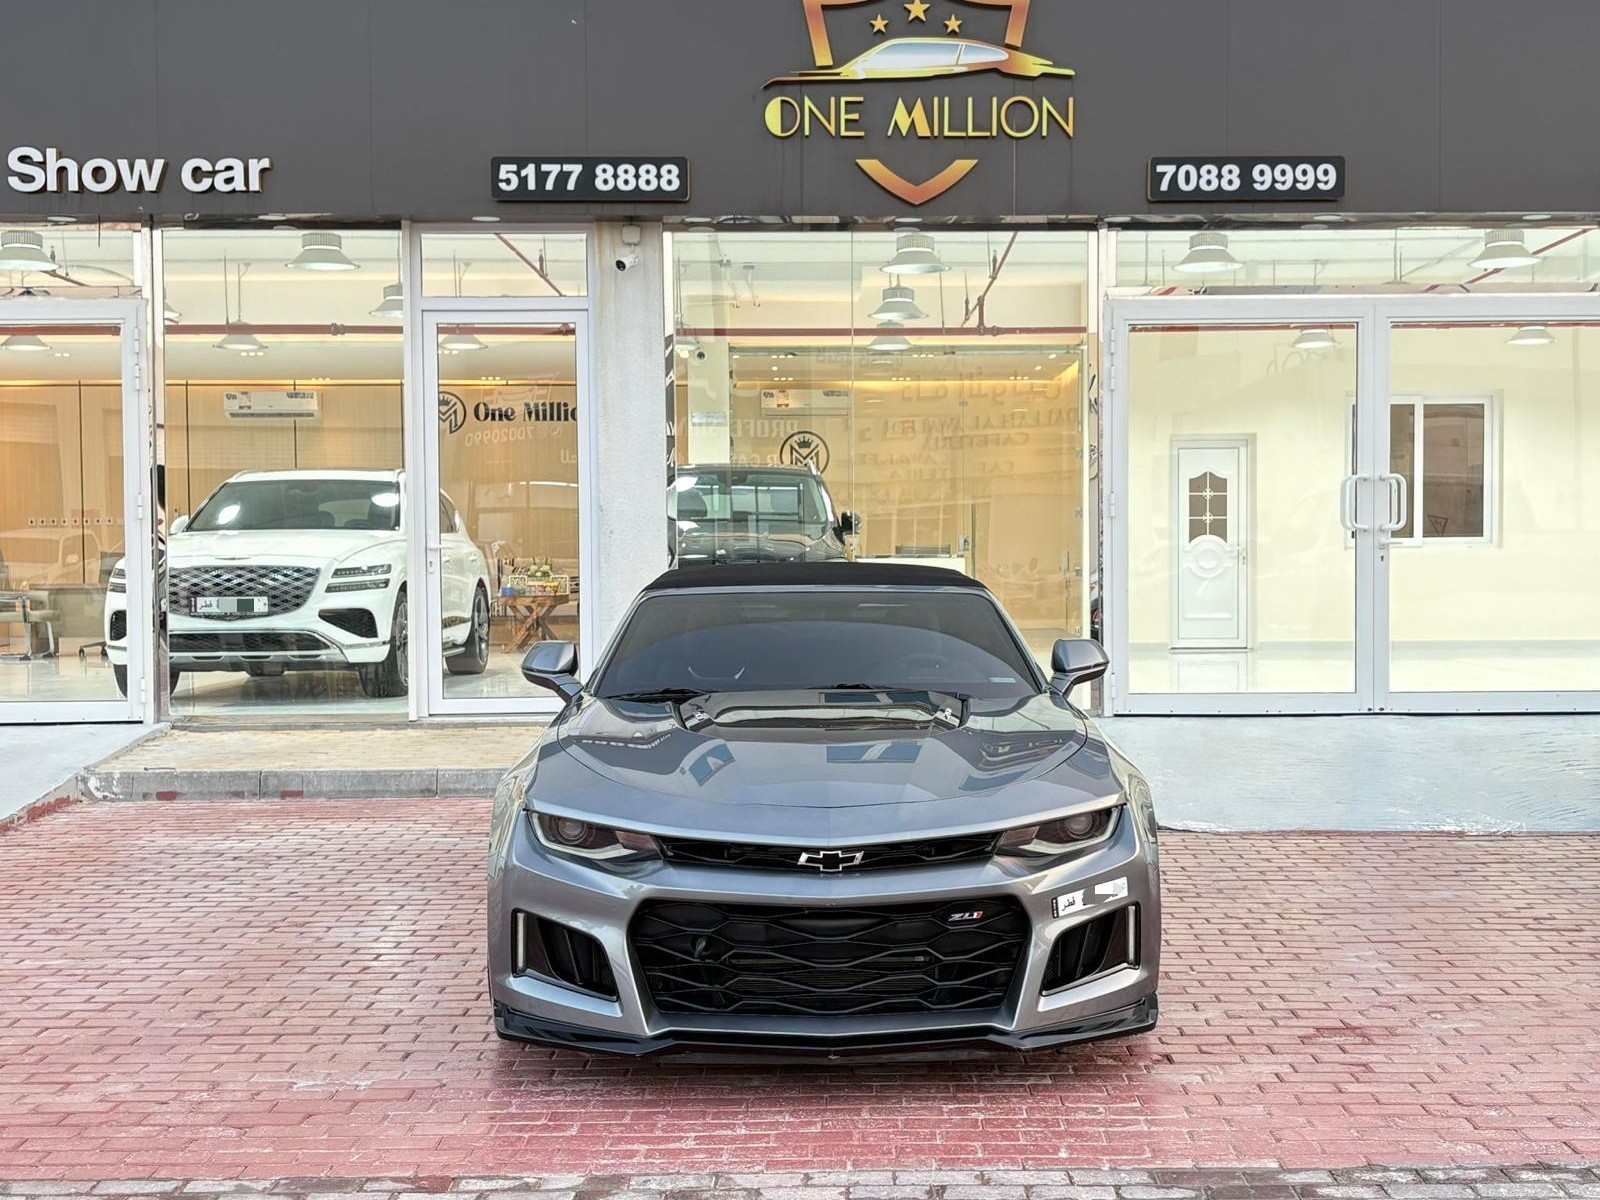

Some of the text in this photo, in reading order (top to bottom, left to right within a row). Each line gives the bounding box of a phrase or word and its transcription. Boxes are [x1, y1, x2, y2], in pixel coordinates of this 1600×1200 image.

[764, 95, 1074, 138] ONE MILLION
[7, 147, 272, 194] Show car
[498, 163, 680, 192] 5177 8888
[1156, 163, 1337, 192] 7088 9999
[473, 401, 517, 422] One
[948, 910, 984, 922] ZL1
